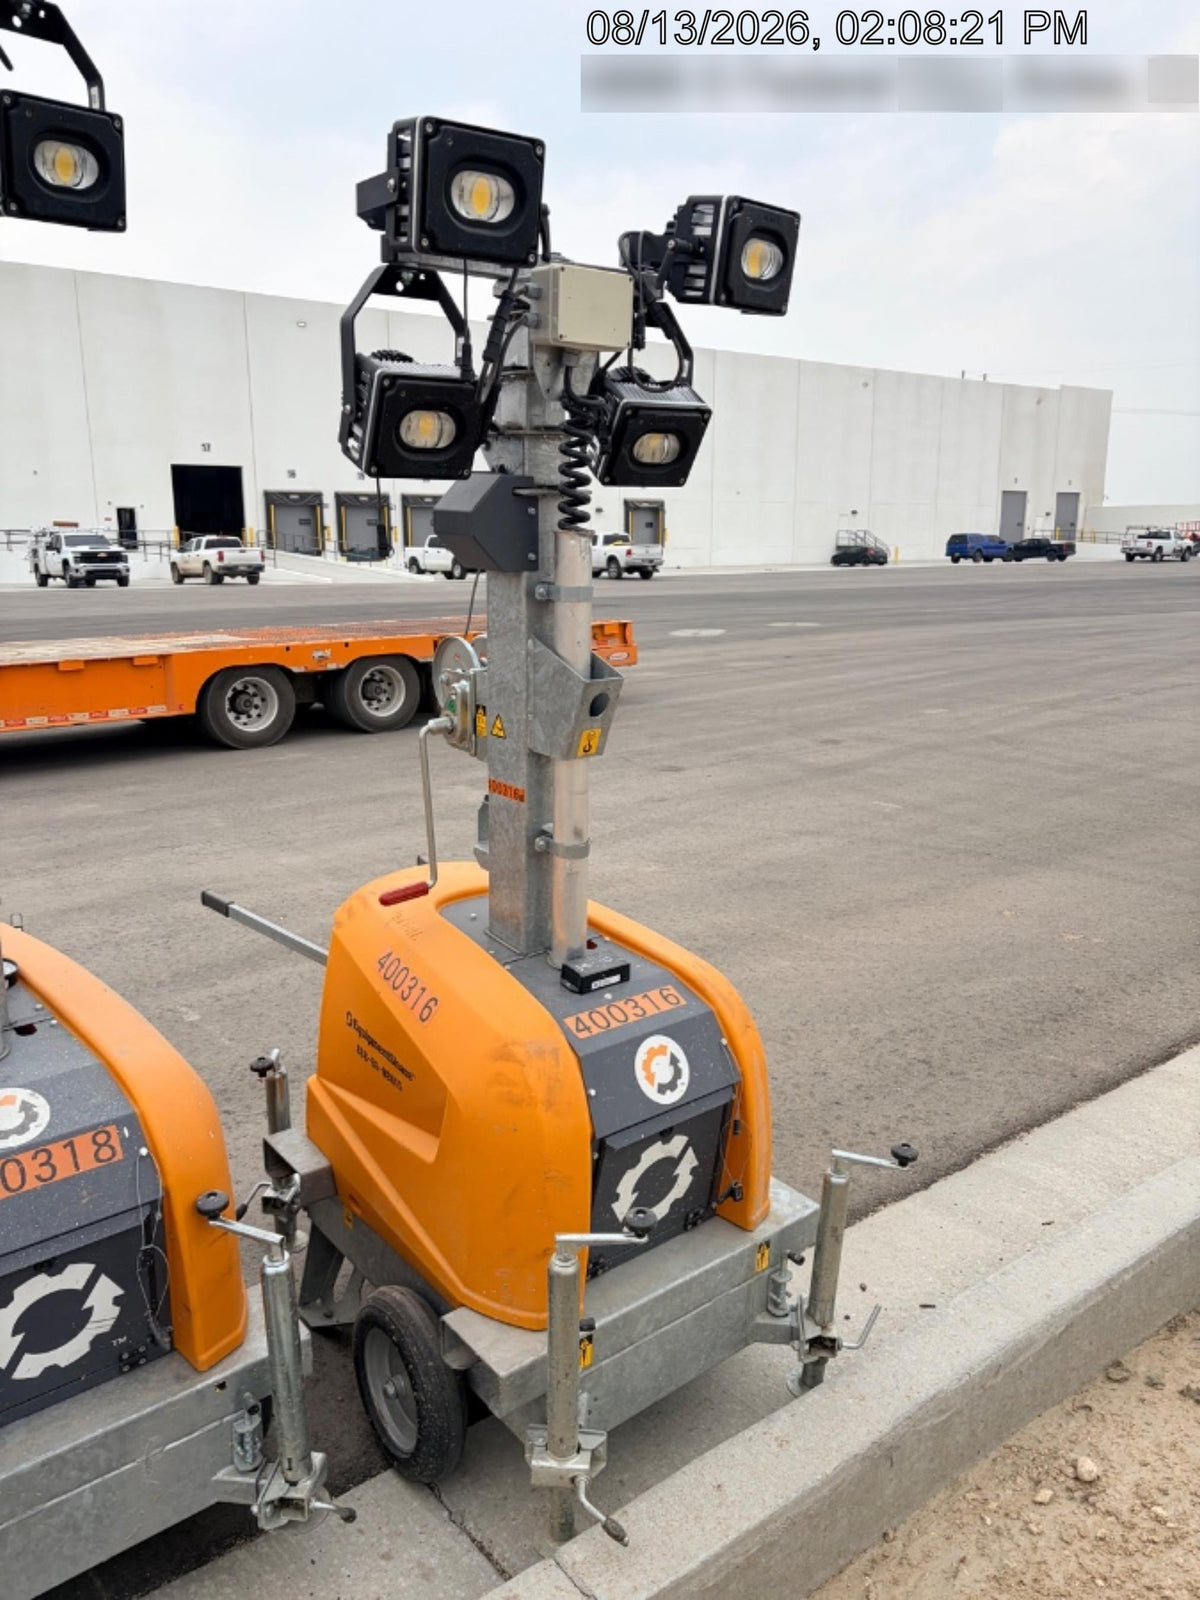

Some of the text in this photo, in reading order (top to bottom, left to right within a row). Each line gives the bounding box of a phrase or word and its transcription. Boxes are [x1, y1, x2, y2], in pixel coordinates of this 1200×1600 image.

[377, 950, 438, 1023] 400316
[574, 988, 681, 1034] 400316
[0, 1129, 117, 1193] 0318
